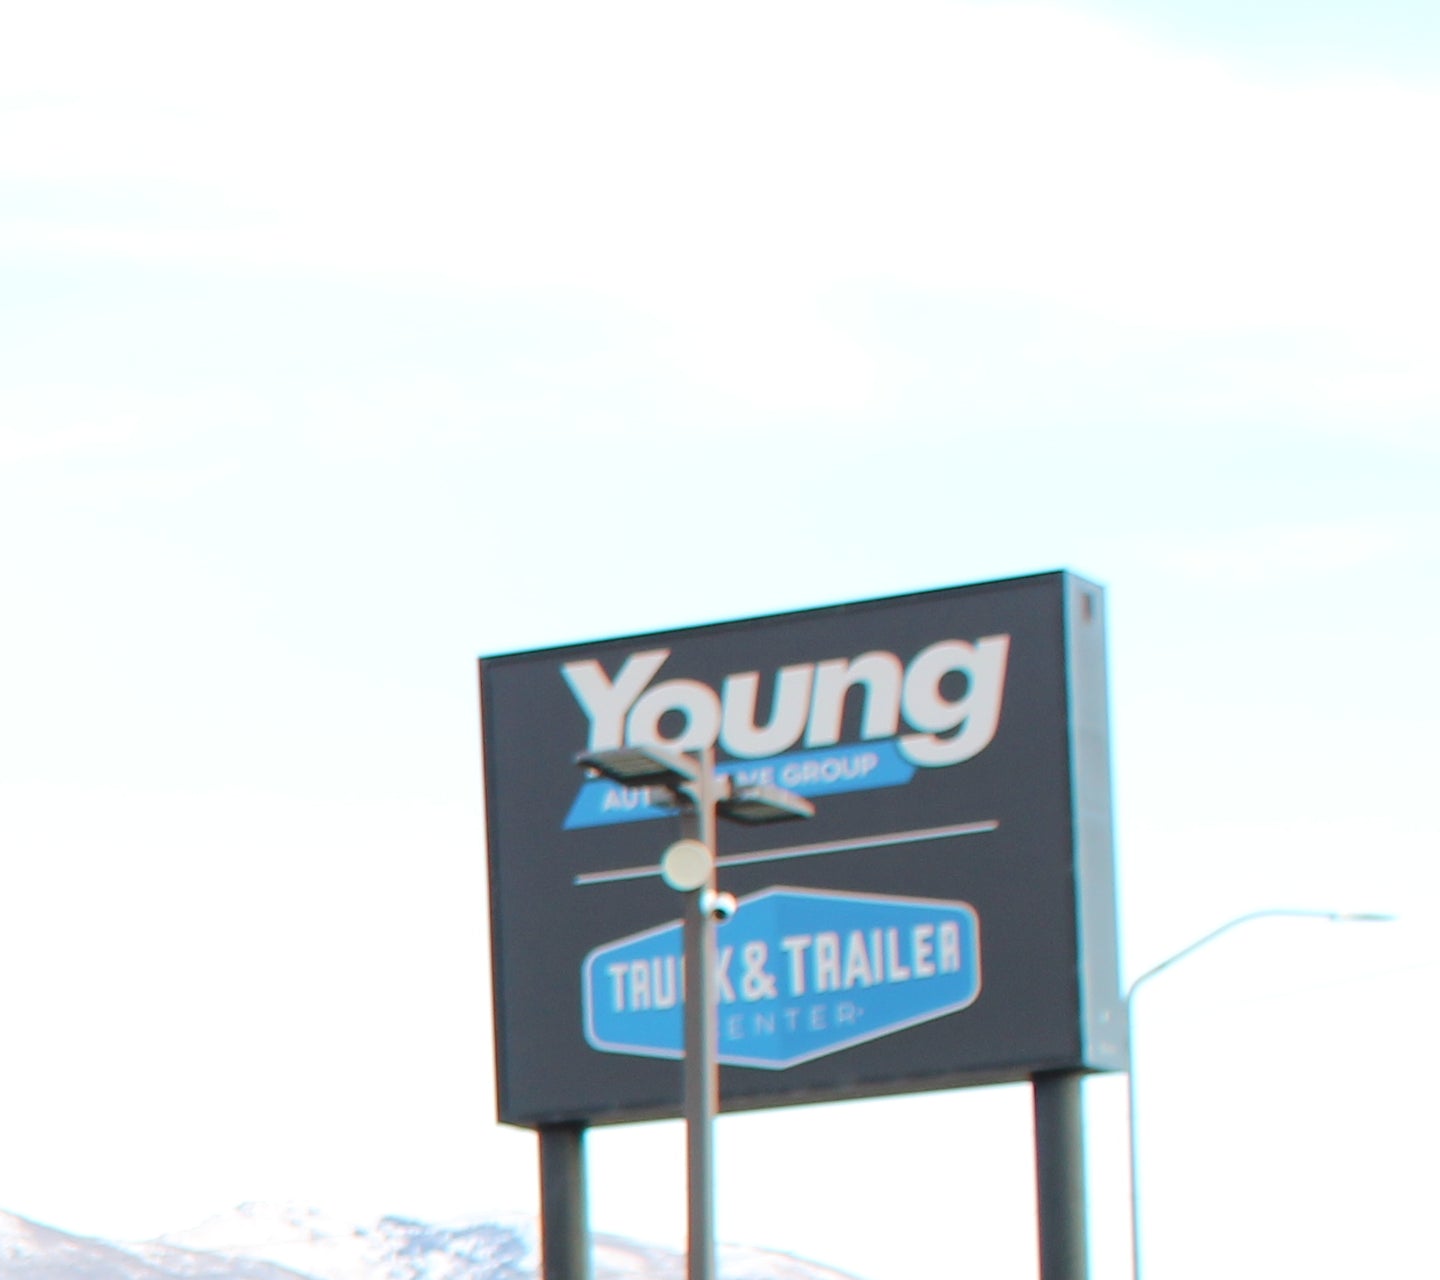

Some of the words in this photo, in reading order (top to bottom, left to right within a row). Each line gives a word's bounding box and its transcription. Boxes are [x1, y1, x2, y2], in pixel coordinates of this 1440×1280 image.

[561, 633, 1011, 767] Young
[783, 753, 879, 788] GROUP
[608, 945, 736, 1012] TRUK
[742, 940, 778, 1000] &
[782, 920, 962, 998] TRAILER
[727, 1001, 858, 1041] ENTER
